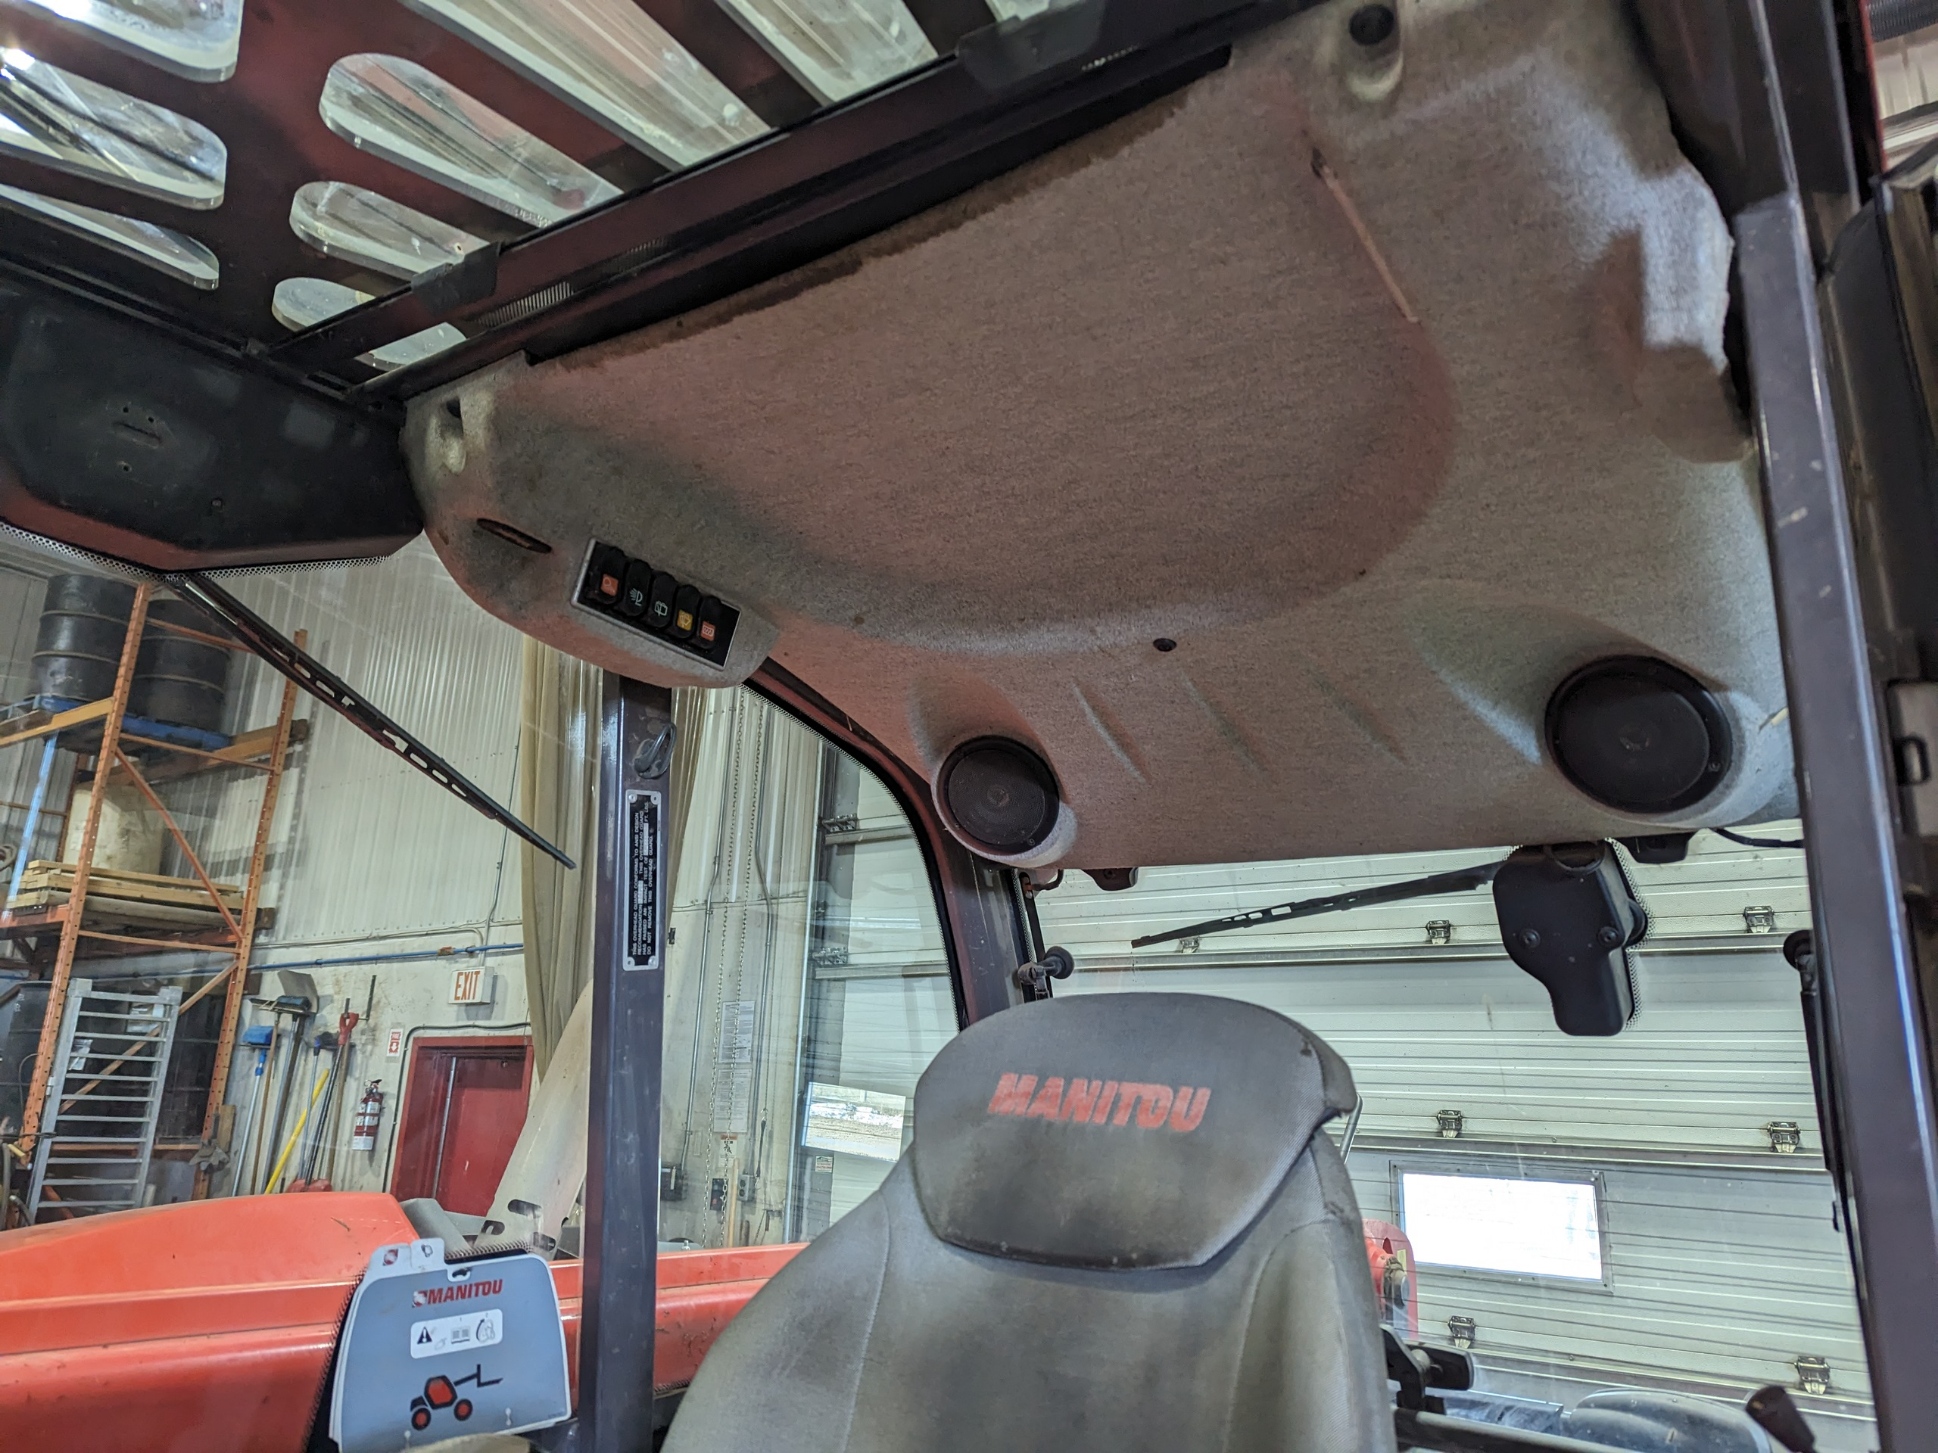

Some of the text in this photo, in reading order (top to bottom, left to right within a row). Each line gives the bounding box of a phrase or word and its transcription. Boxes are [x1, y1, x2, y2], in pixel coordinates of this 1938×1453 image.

[647, 946, 651, 955] DO
[454, 971, 480, 1000] EXIT
[987, 1072, 1211, 1133] MANITOU
[427, 1279, 503, 1305] MANITOU
